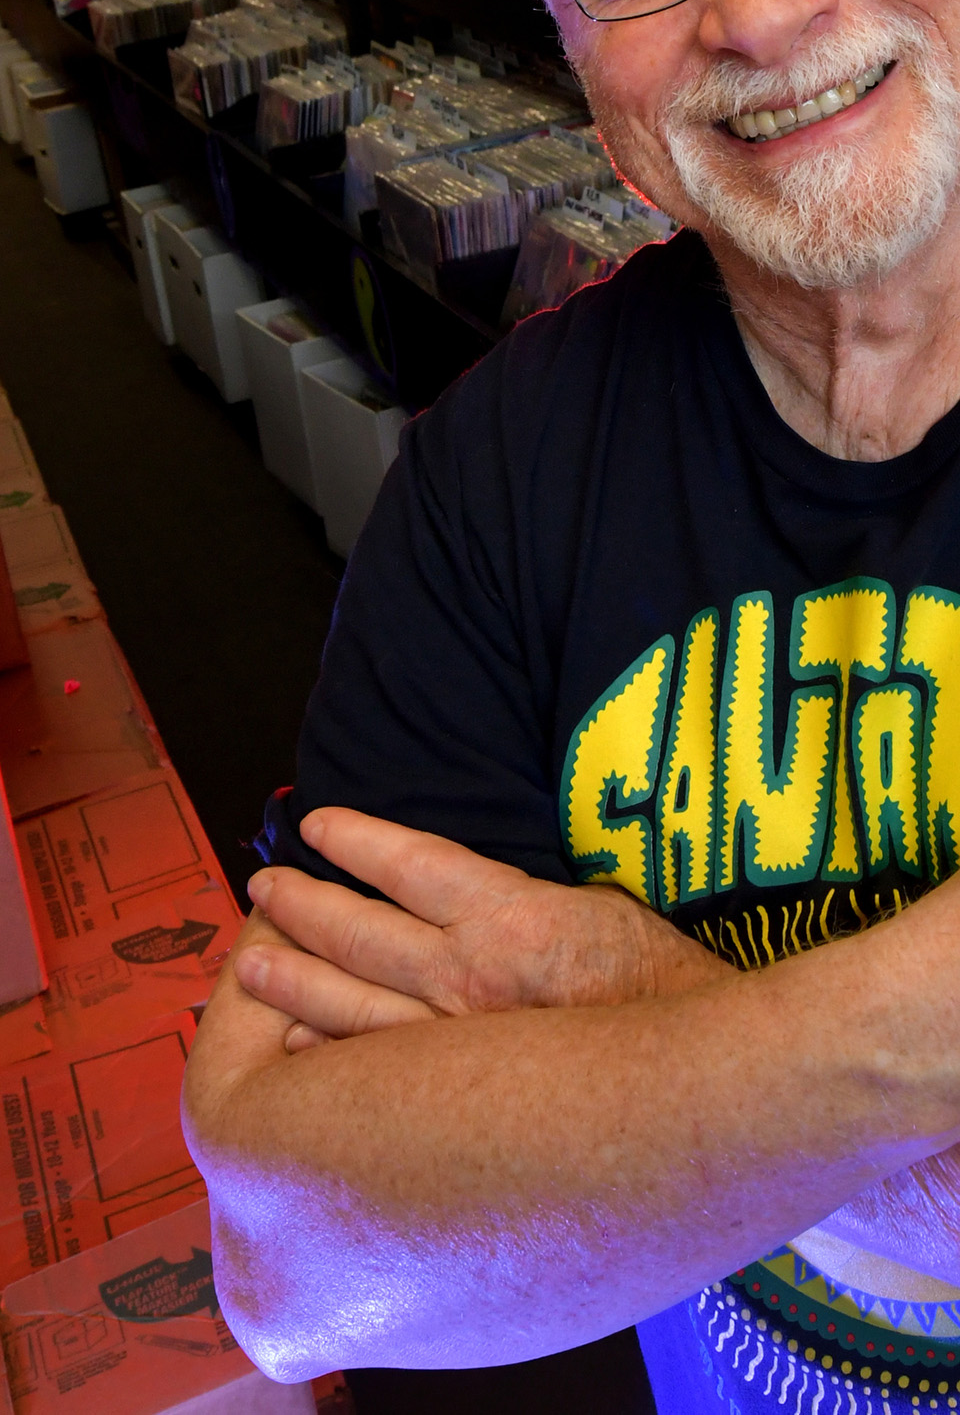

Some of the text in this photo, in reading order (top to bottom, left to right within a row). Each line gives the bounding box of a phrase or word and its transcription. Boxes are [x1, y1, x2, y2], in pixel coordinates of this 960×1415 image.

[41, 1110, 57, 1138] Years
[8, 1126, 34, 1180] MULTIPLE
[17, 1181, 39, 1207] FOR
[128, 1281, 179, 1311] FEATURE
